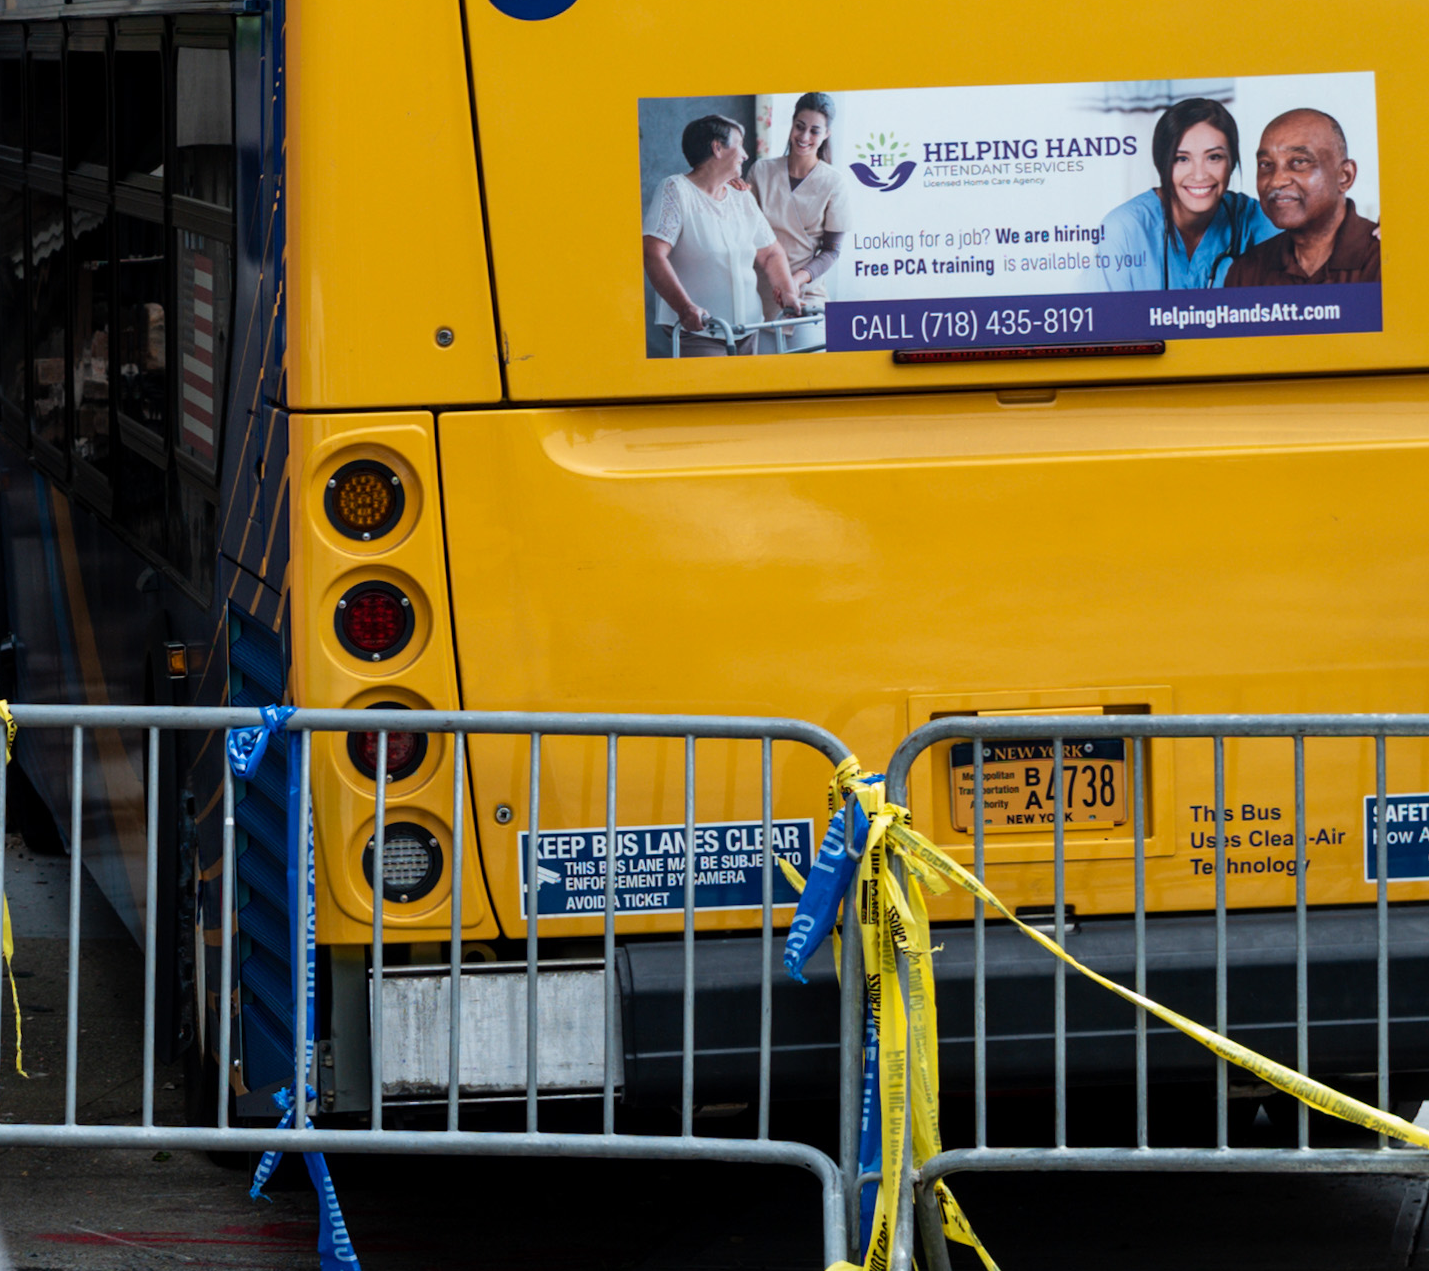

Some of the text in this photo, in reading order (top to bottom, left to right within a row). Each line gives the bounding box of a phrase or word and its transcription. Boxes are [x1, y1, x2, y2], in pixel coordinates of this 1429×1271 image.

[923, 136, 1137, 163] HELPING HANDS
[923, 160, 1084, 177] ATTENDANT SERVICES
[923, 176, 1045, 188] Licensed Home Care Agency
[854, 225, 1106, 252] Looking for a job? We are hiring!
[855, 250, 1147, 277] Free PCA training is available to you!
[852, 307, 1094, 342] CALL (718) 435-8191
[1149, 303, 1340, 329] HelpingHandsAtt.com
[995, 747, 1035, 761] NEW
[1025, 767, 1040, 787] B
[1045, 764, 1116, 809] 4738
[1025, 790, 1044, 809] A
[1006, 812, 1074, 825] NEW YOK
[1190, 804, 1282, 823] Ths Bus
[645, 830, 719, 856] LANES
[725, 826, 800, 851] CLEAR
[1190, 828, 1347, 849] Uses Clea-Air
[564, 851, 802, 875] THIS BS LANE MA BE SUBJET TO
[667, 873, 685, 887] BY
[566, 895, 607, 910] AVOID
[623, 892, 670, 908] TICKET
